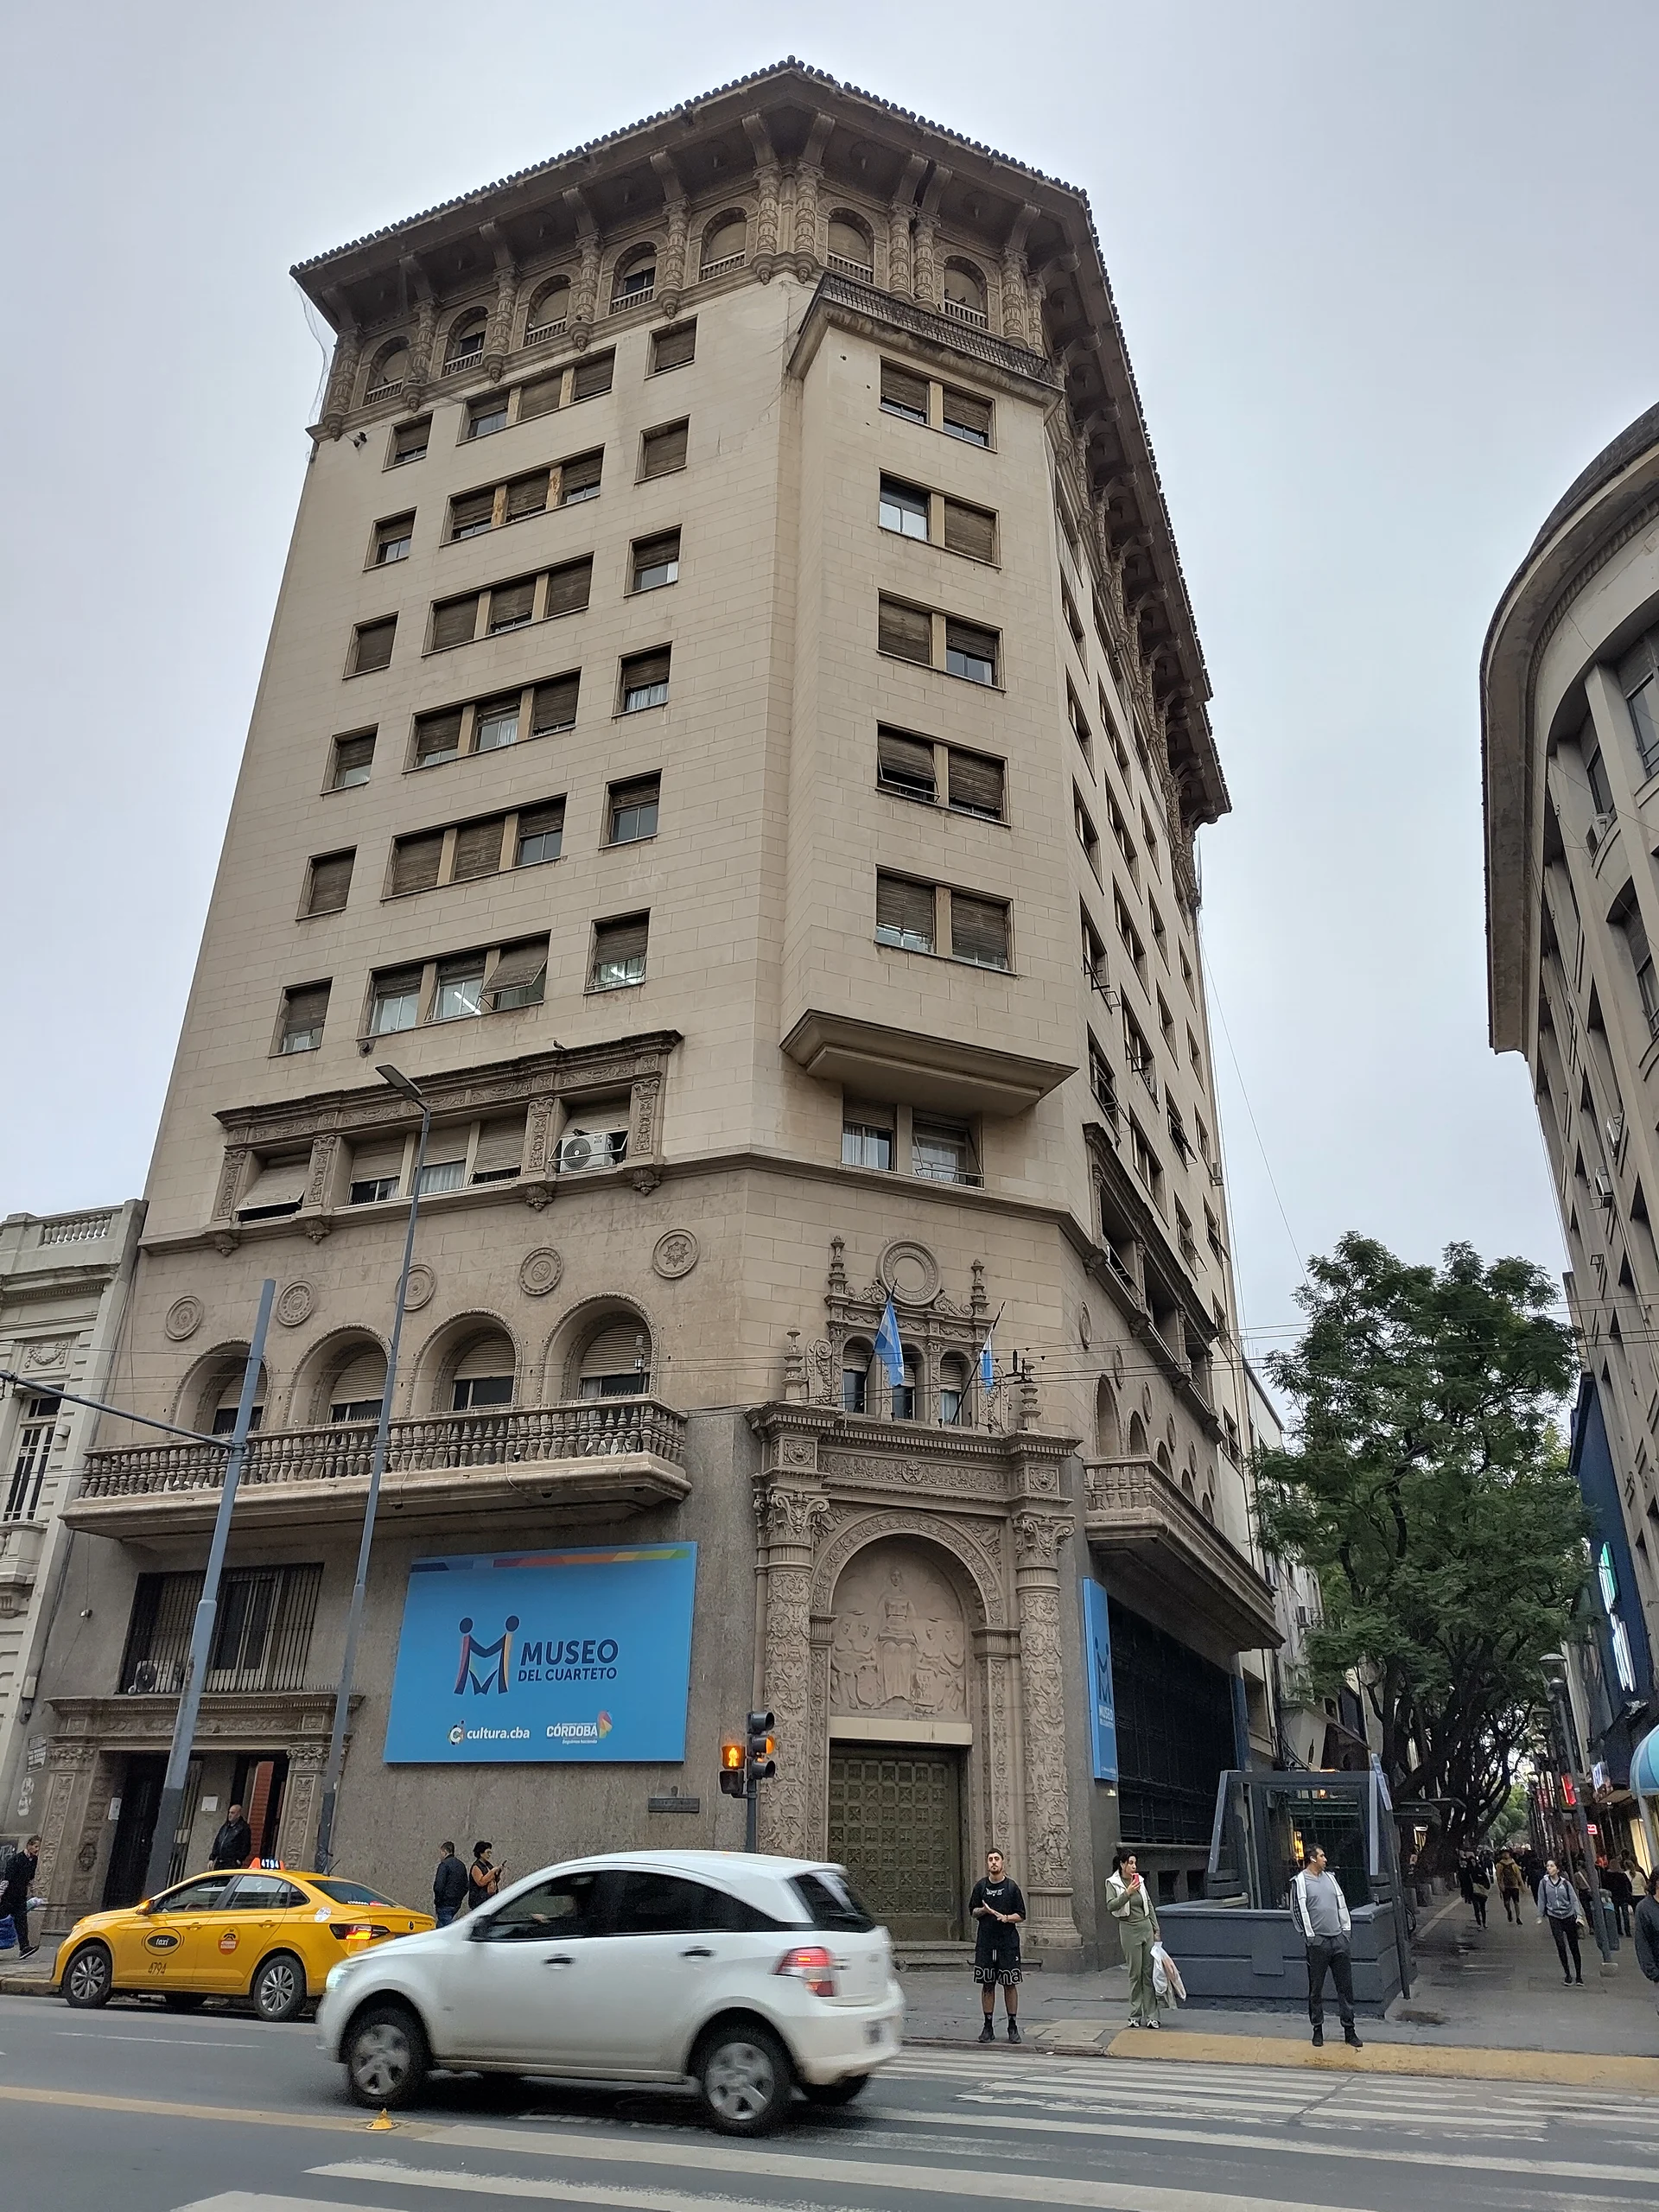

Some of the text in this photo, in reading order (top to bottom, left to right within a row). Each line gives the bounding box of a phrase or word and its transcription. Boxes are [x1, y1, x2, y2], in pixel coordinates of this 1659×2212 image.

[520, 1638, 619, 1666] MUSEO
[518, 1667, 617, 1682] DEL CUARTETO
[467, 1726, 531, 1739] cultura.cba
[546, 1723, 598, 1737] CÓRDOBA
[261, 1859, 279, 1869] 4794
[148, 1961, 167, 1975] 4794
